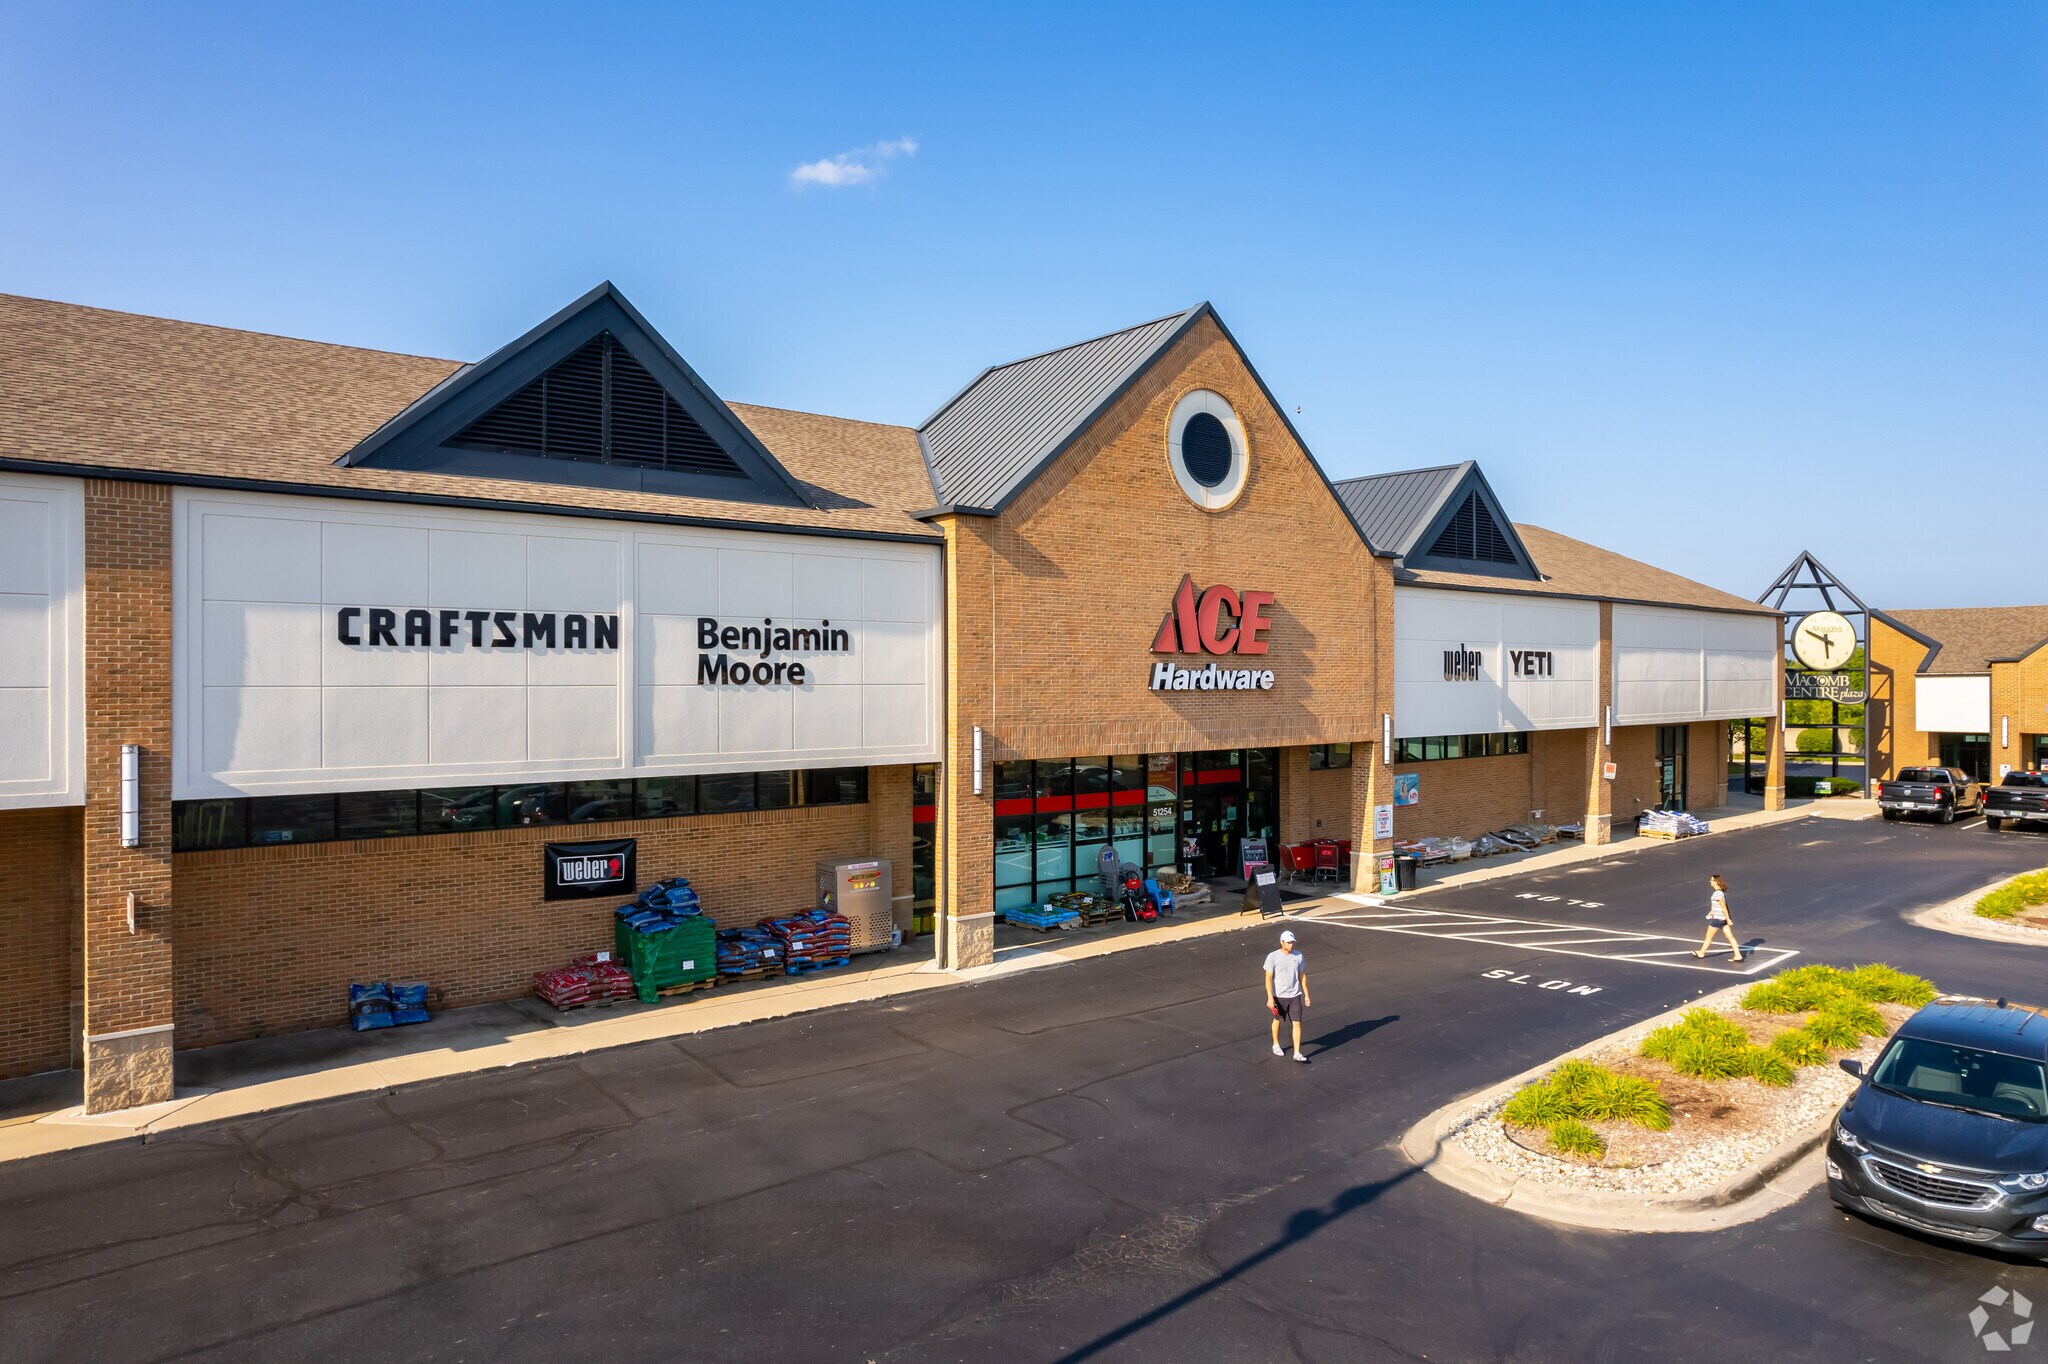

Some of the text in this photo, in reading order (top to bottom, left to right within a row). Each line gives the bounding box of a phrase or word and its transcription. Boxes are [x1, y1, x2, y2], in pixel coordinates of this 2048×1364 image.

[1150, 573, 1275, 655] ACE
[338, 607, 618, 649] CRAFTSMAN
[697, 617, 849, 659] Benjamin
[697, 654, 805, 685] Moore
[1443, 643, 1481, 681] weber
[1510, 651, 1551, 676] YETI
[1151, 662, 1275, 690] Hardware
[1785, 672, 1850, 686] MACOMB
[1785, 687, 1864, 700] CENTRE plaza
[1153, 807, 1172, 816] 51254
[562, 858, 608, 881] weber
[1515, 893, 1605, 908] SLOW
[1481, 969, 1603, 996] SLOW
